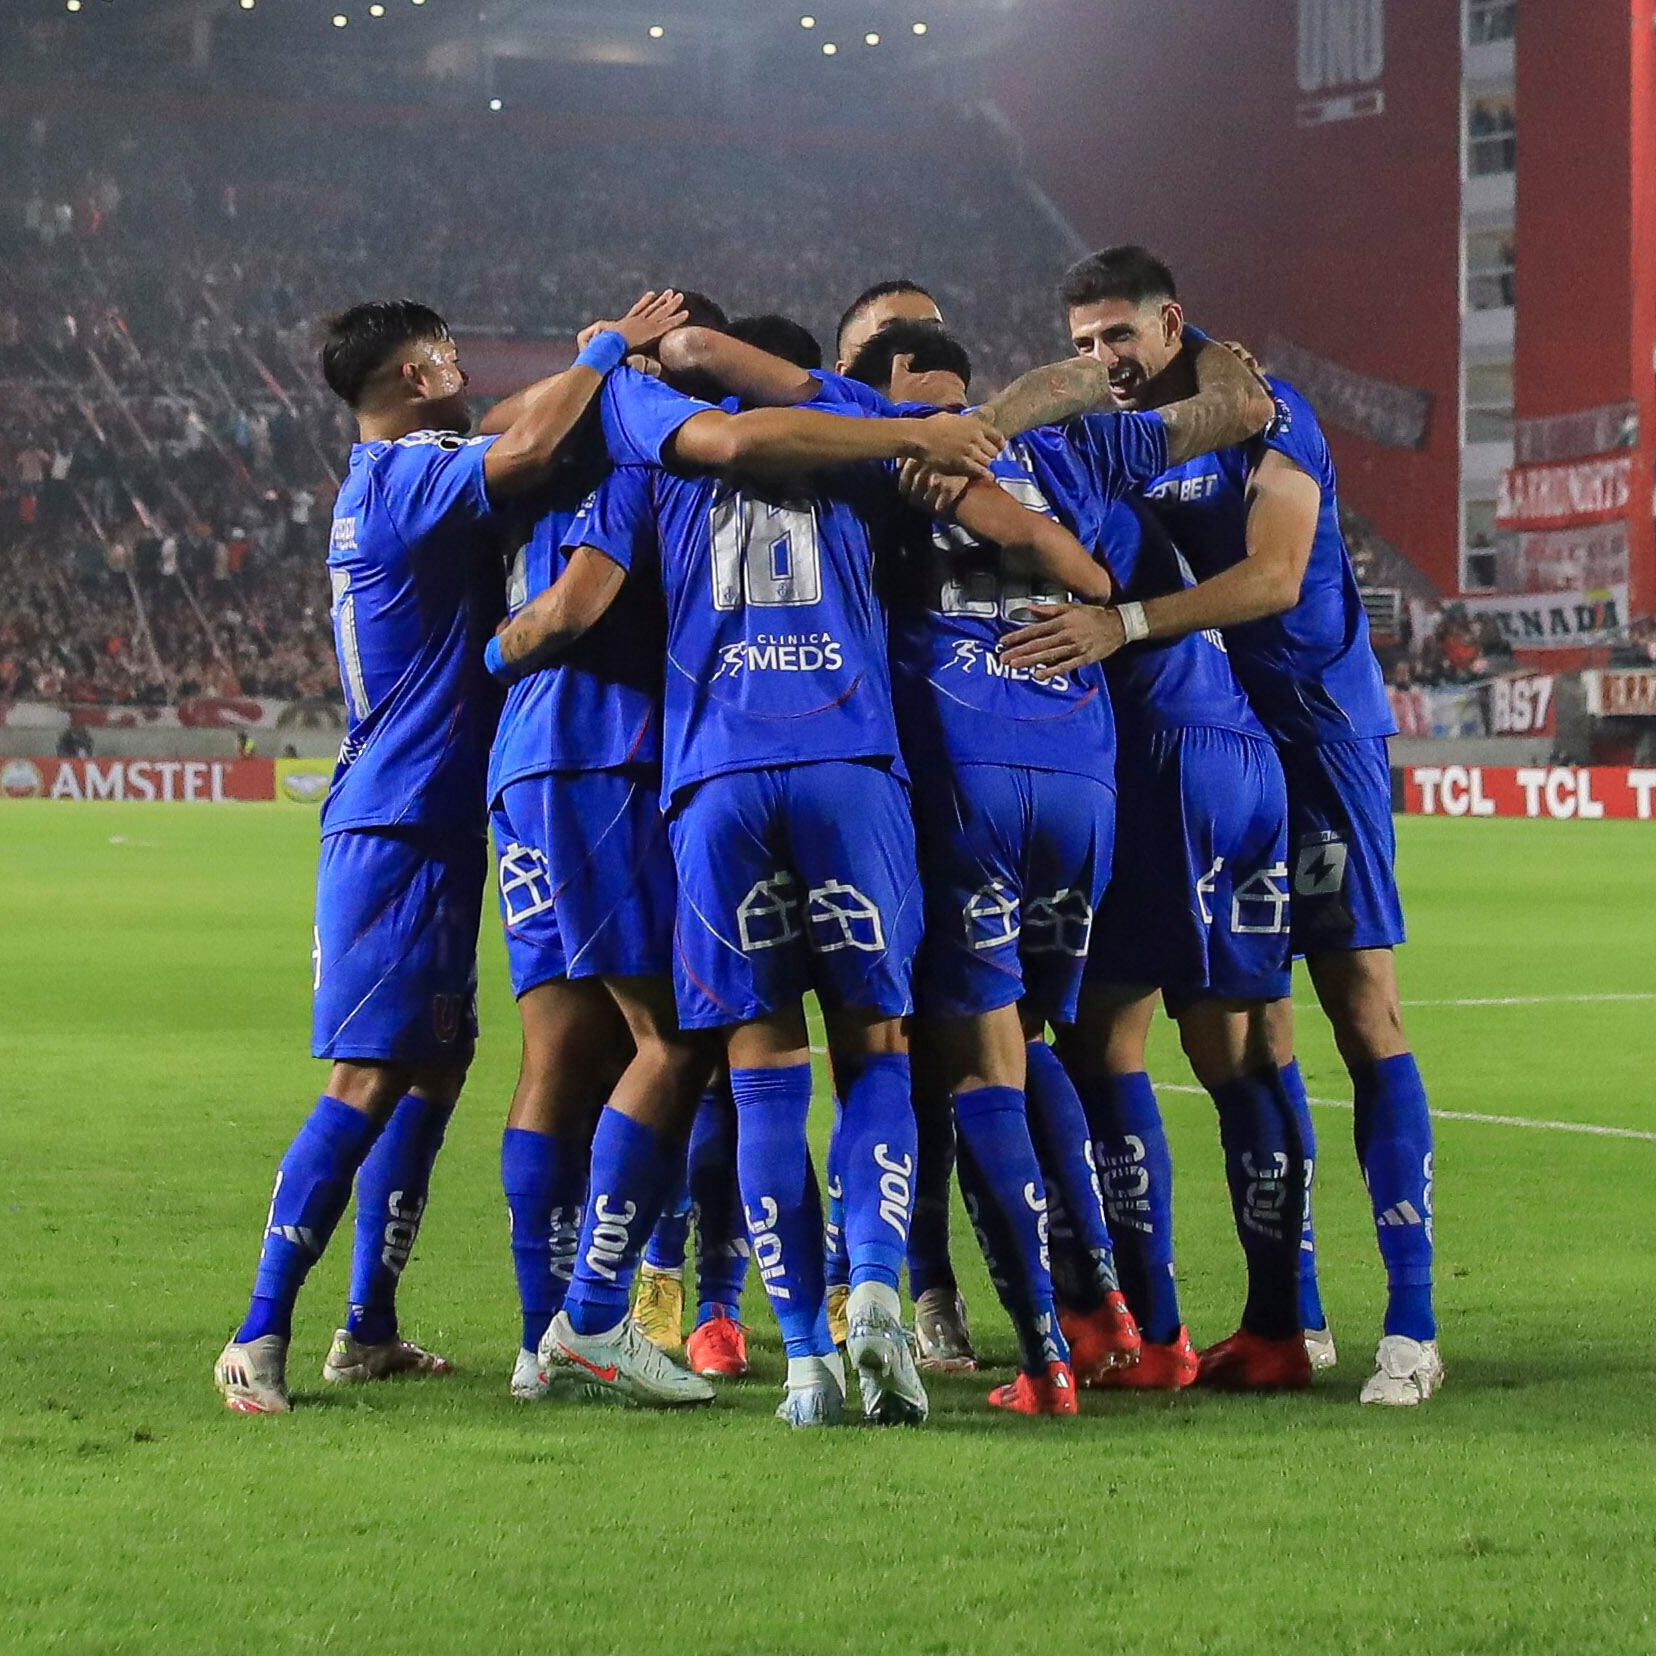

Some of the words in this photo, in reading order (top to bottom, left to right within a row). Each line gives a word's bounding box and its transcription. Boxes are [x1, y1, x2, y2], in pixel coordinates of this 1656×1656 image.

[749, 642, 843, 672] MEDS
[757, 632, 832, 645] CLINICA
[49, 758, 229, 802] AMSTEL
[1413, 766, 1495, 816] TCL
[1516, 768, 1604, 819] TCL
